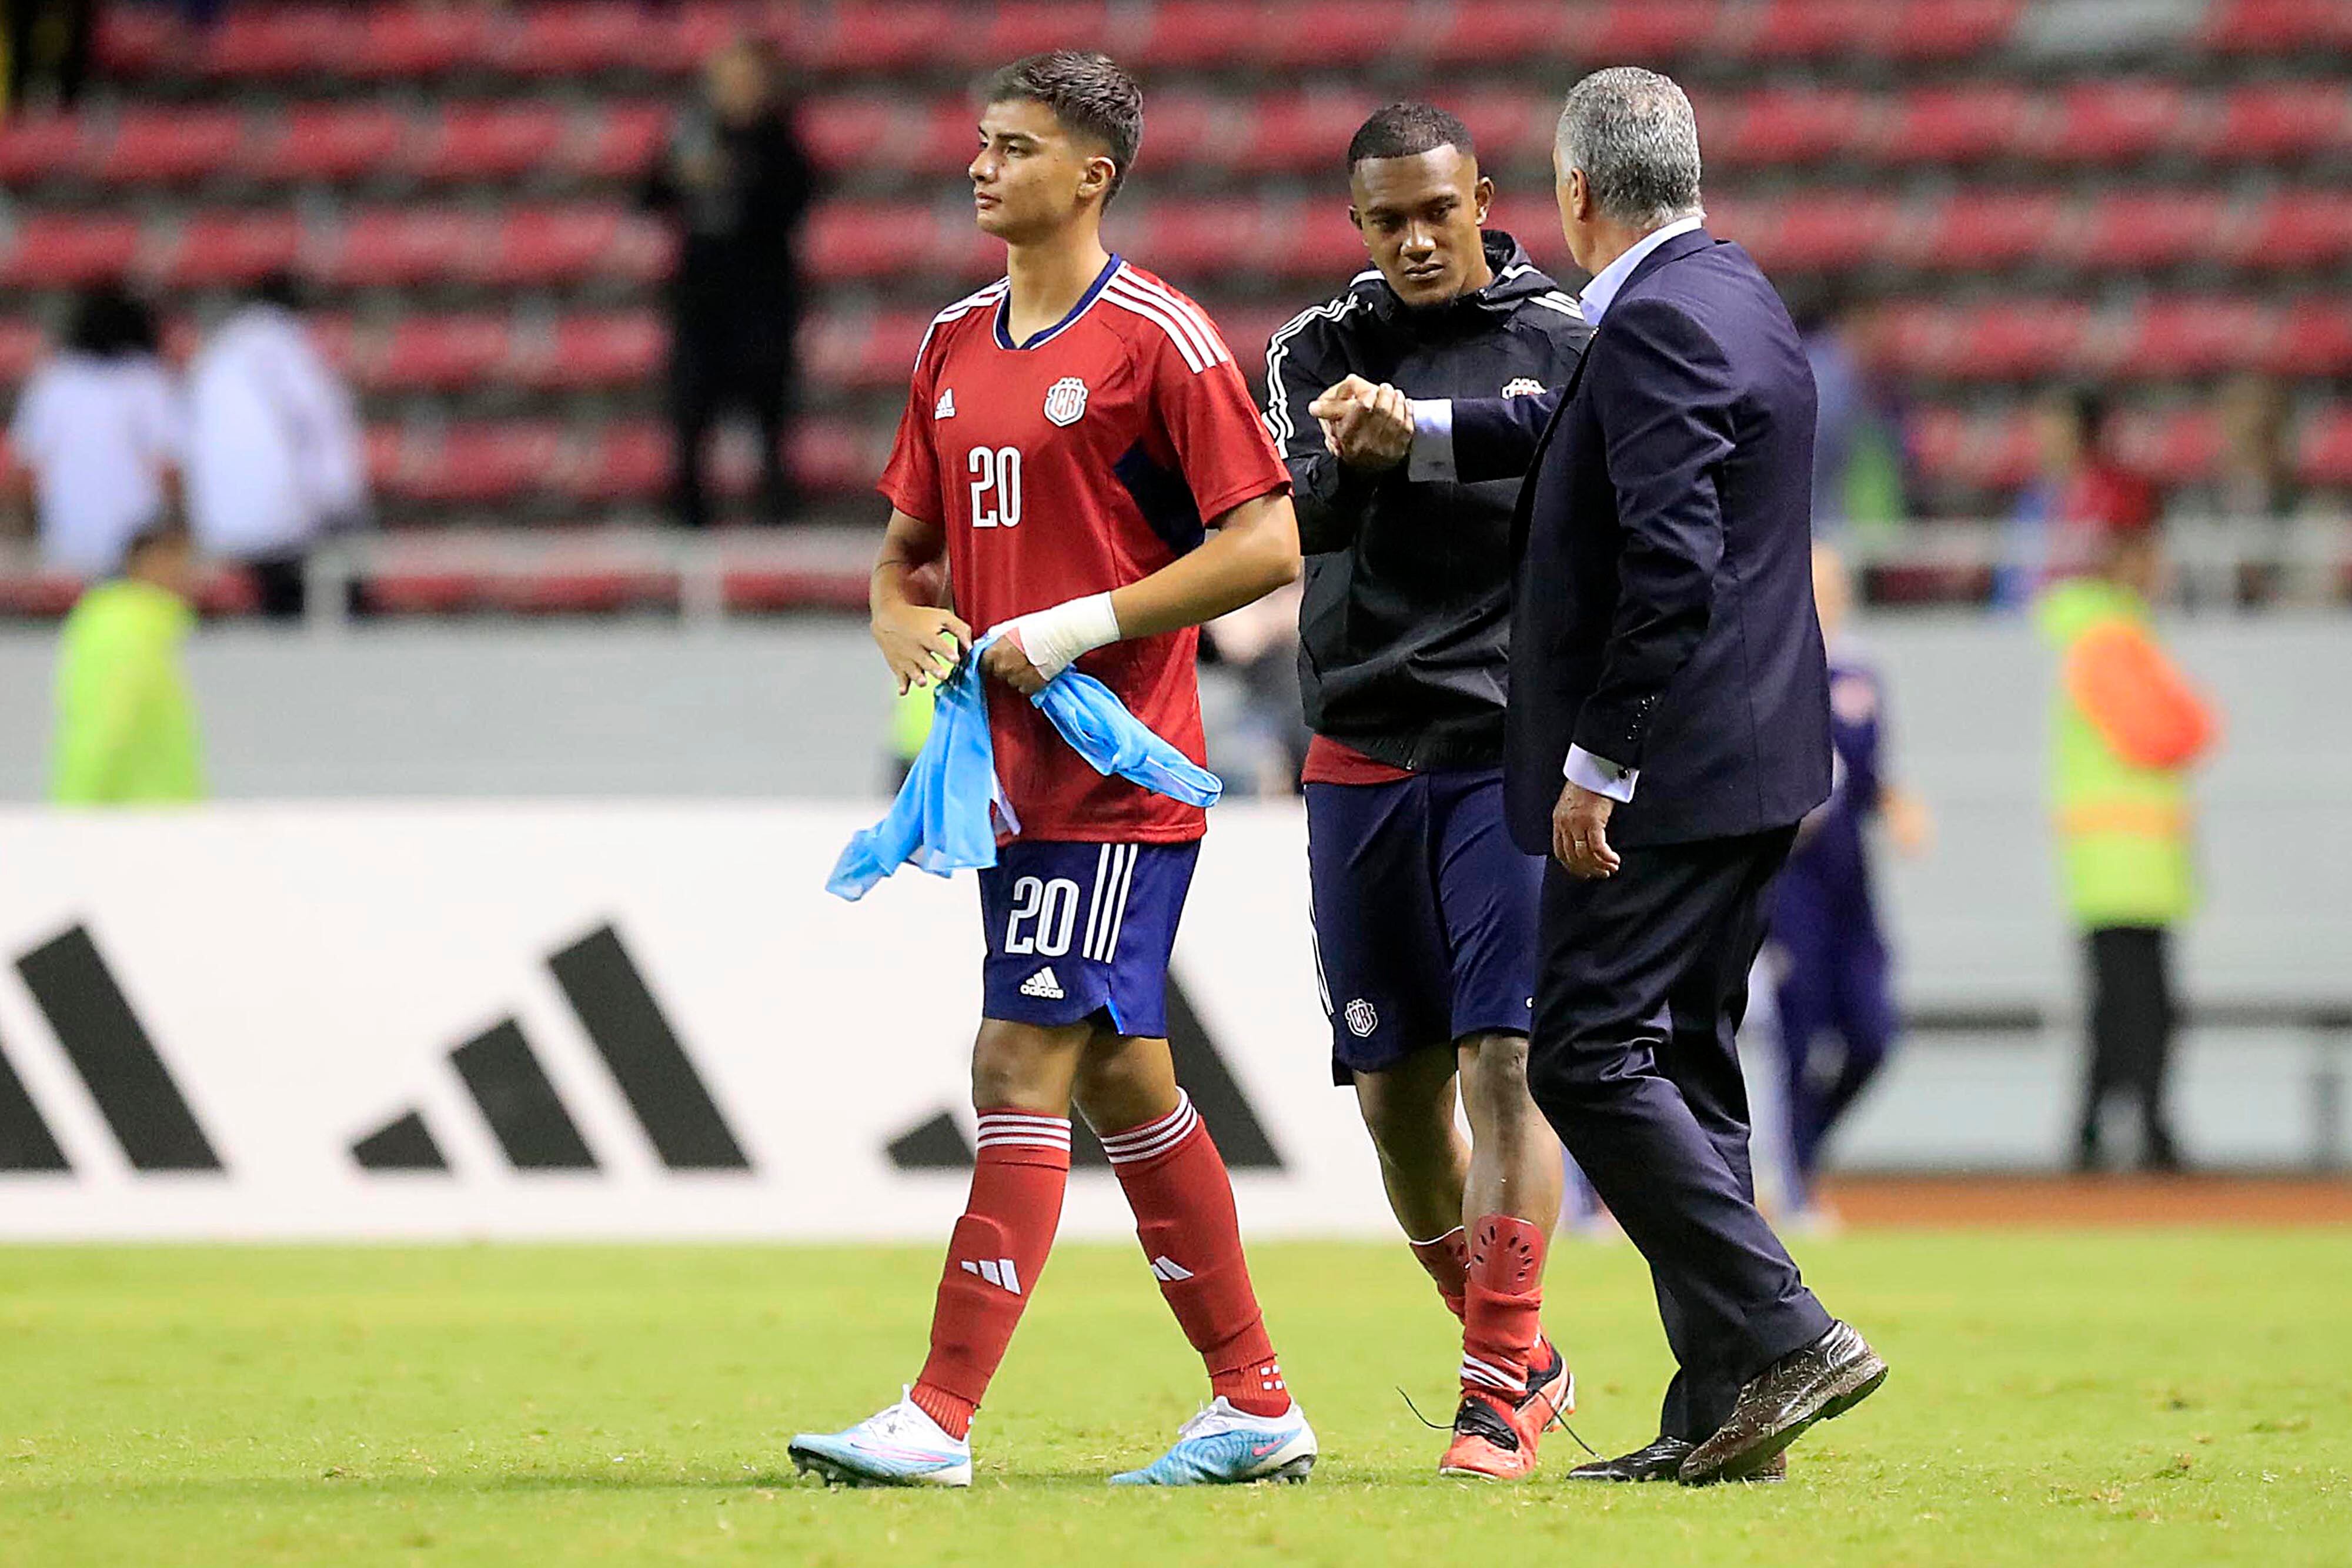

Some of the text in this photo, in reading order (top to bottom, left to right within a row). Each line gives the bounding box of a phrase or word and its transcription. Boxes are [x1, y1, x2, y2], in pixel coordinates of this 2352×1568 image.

[968, 446, 1022, 528] 20
[1004, 876, 1080, 957] 20
[1020, 984, 1064, 999] adidas
